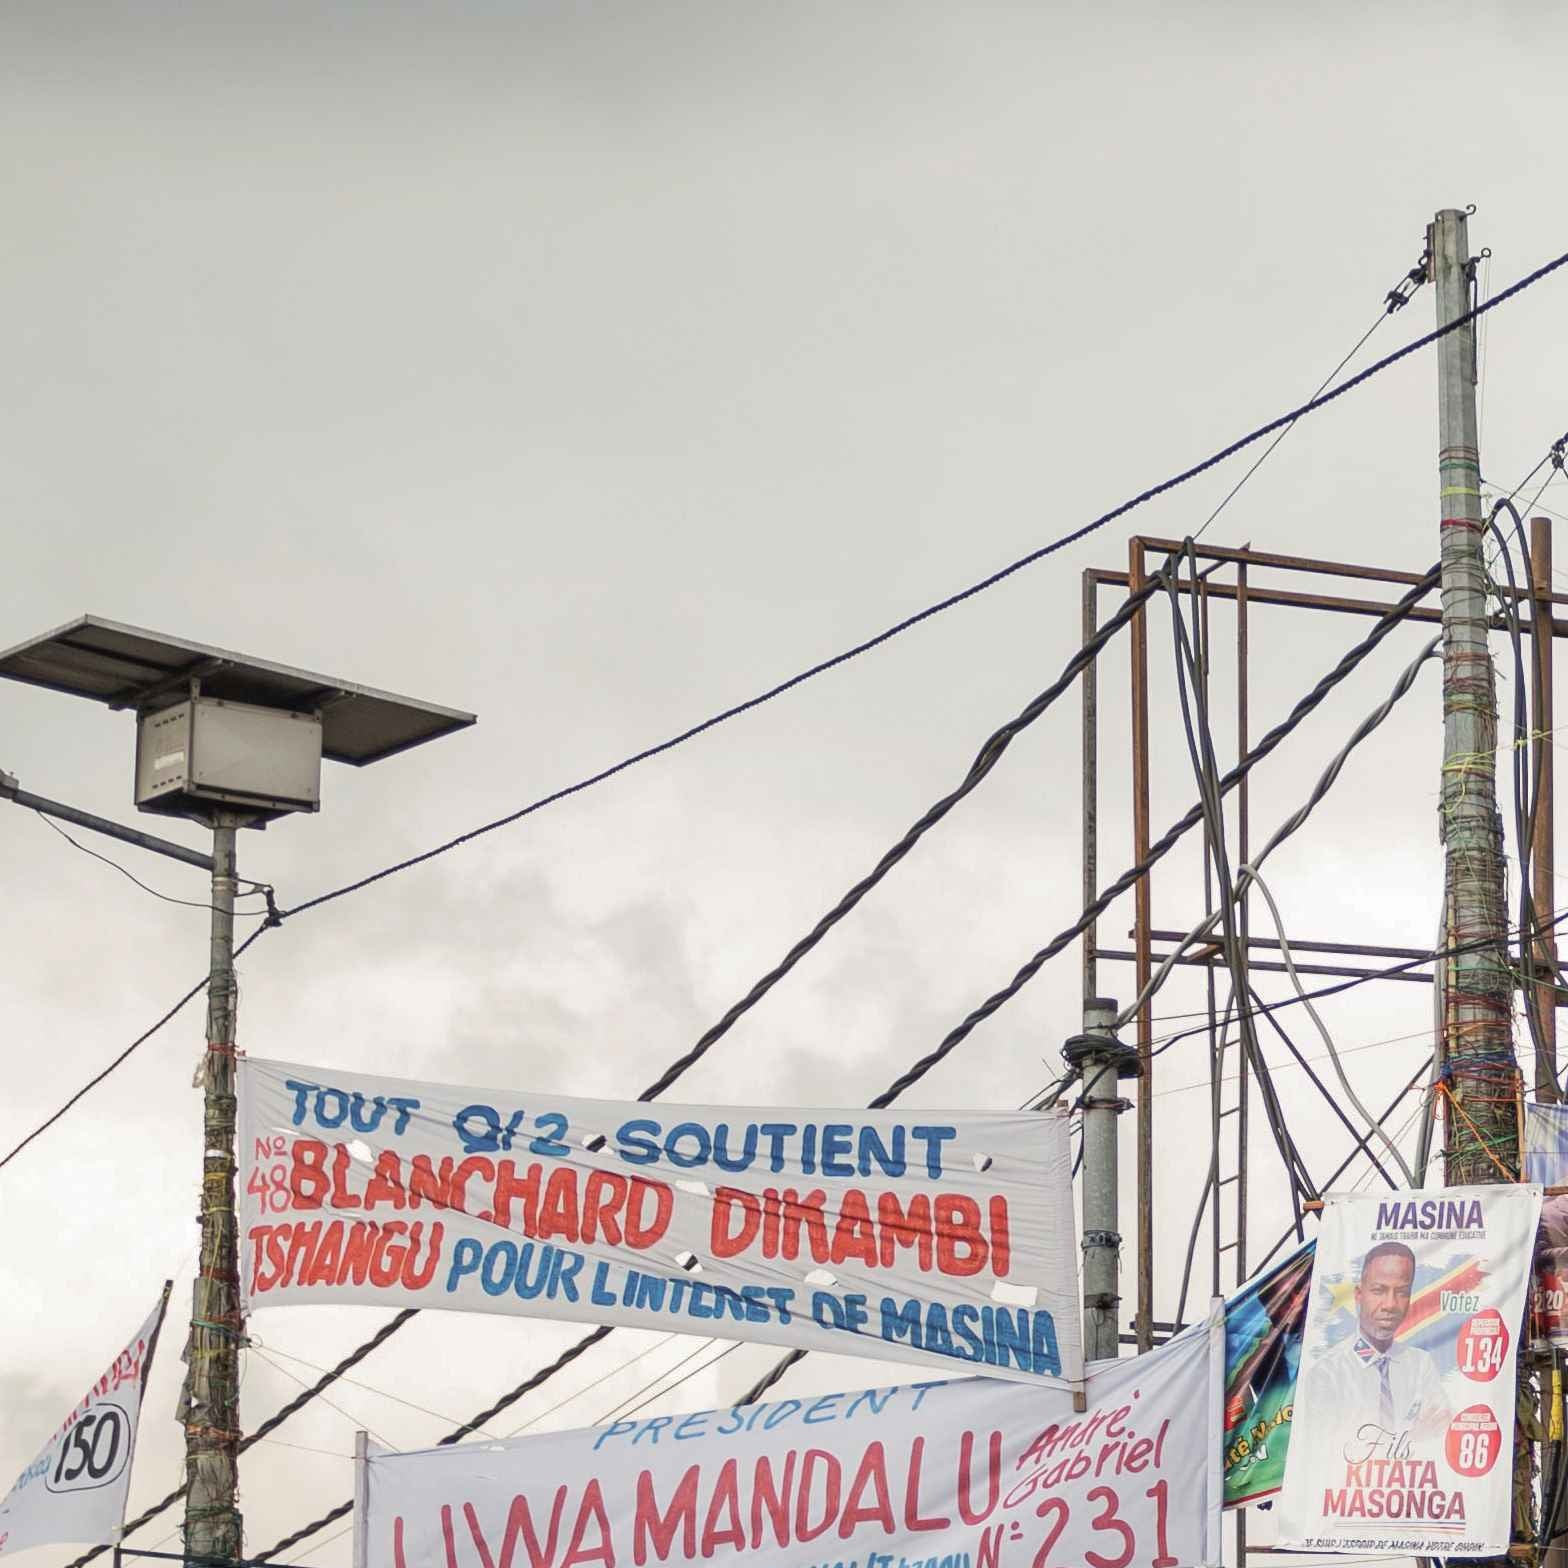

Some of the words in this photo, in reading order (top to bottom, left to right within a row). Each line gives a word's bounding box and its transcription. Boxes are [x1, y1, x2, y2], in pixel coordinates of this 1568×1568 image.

[286, 1079, 420, 1137] TOUT
[614, 1119, 957, 1180] SOUTIENT
[289, 1139, 674, 1249] BLANCHARD
[710, 1186, 1010, 1278] DIKAMBI
[1376, 1199, 1484, 1230] MASINA
[249, 1220, 444, 1296] TSHANGU
[446, 1239, 584, 1303] POUR
[1462, 1337, 1503, 1374] 134
[54, 1411, 120, 1484] 150
[1345, 1460, 1438, 1489] KITATA
[1458, 1433, 1488, 1469] 86
[634, 1430, 1002, 1561] MANDALU
[1323, 1488, 1467, 1521] MASONGA
